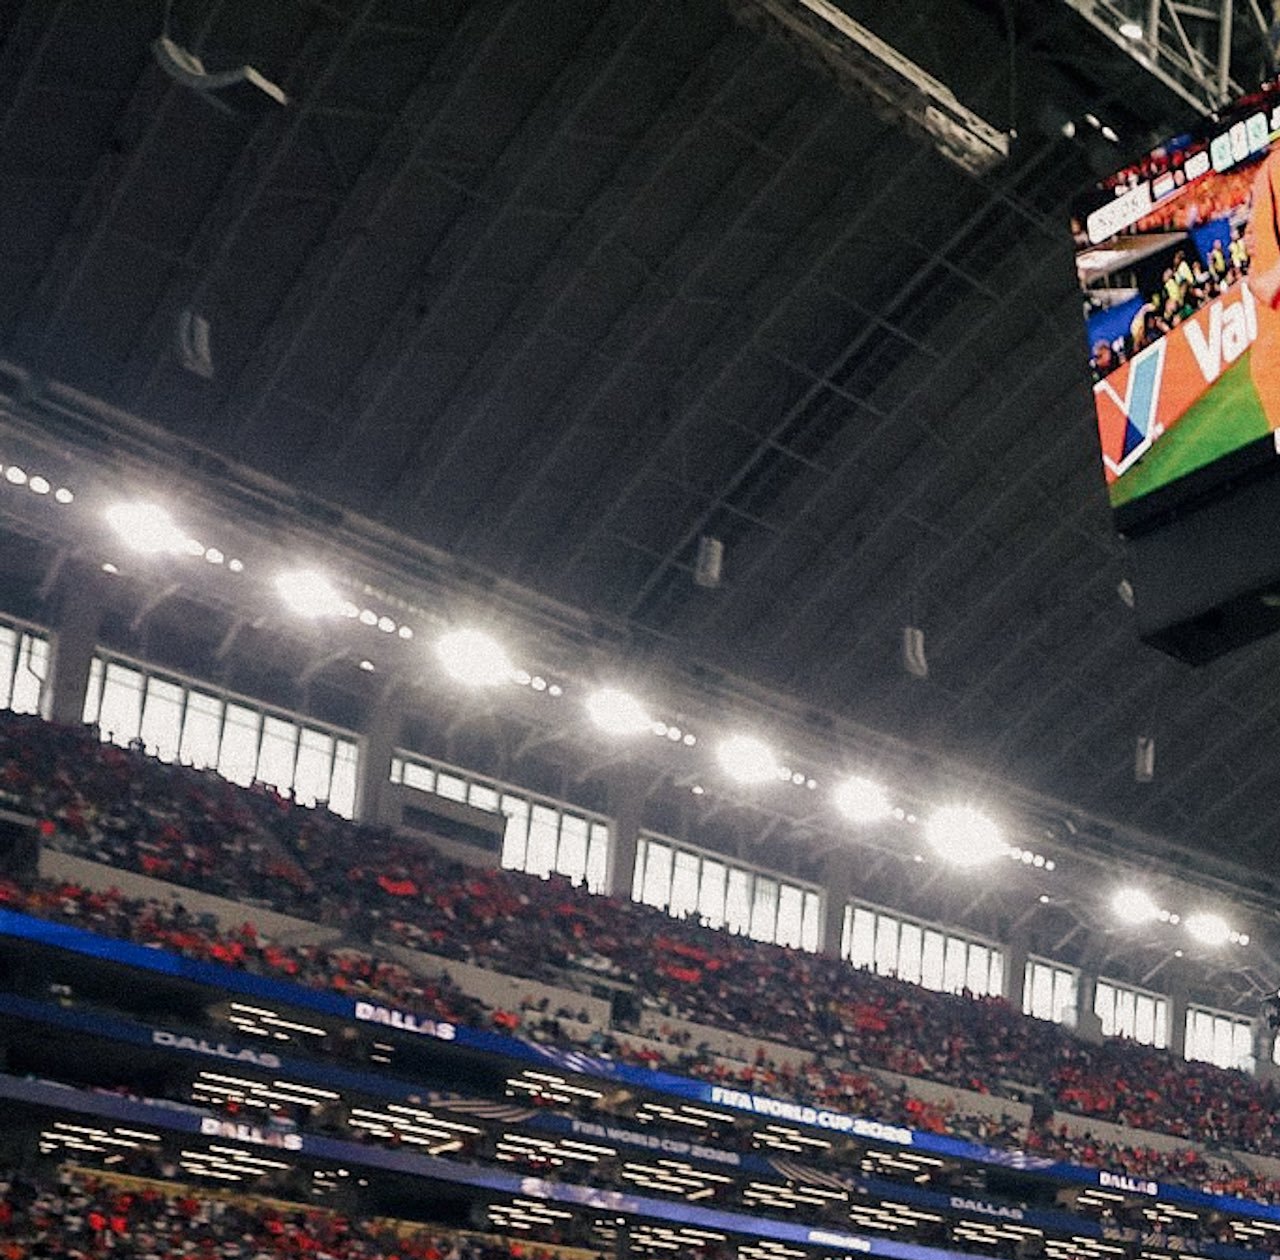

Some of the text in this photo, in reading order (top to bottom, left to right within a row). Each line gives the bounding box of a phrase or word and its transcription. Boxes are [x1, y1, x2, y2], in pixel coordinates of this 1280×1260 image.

[354, 1001, 456, 1041] DALLAS
[152, 1030, 281, 1069] DALLAS
[752, 1094, 817, 1124] WORLD
[817, 1107, 852, 1132] CUP
[201, 1116, 303, 1151] DALLAS
[1100, 1170, 1158, 1197] DALLAS
